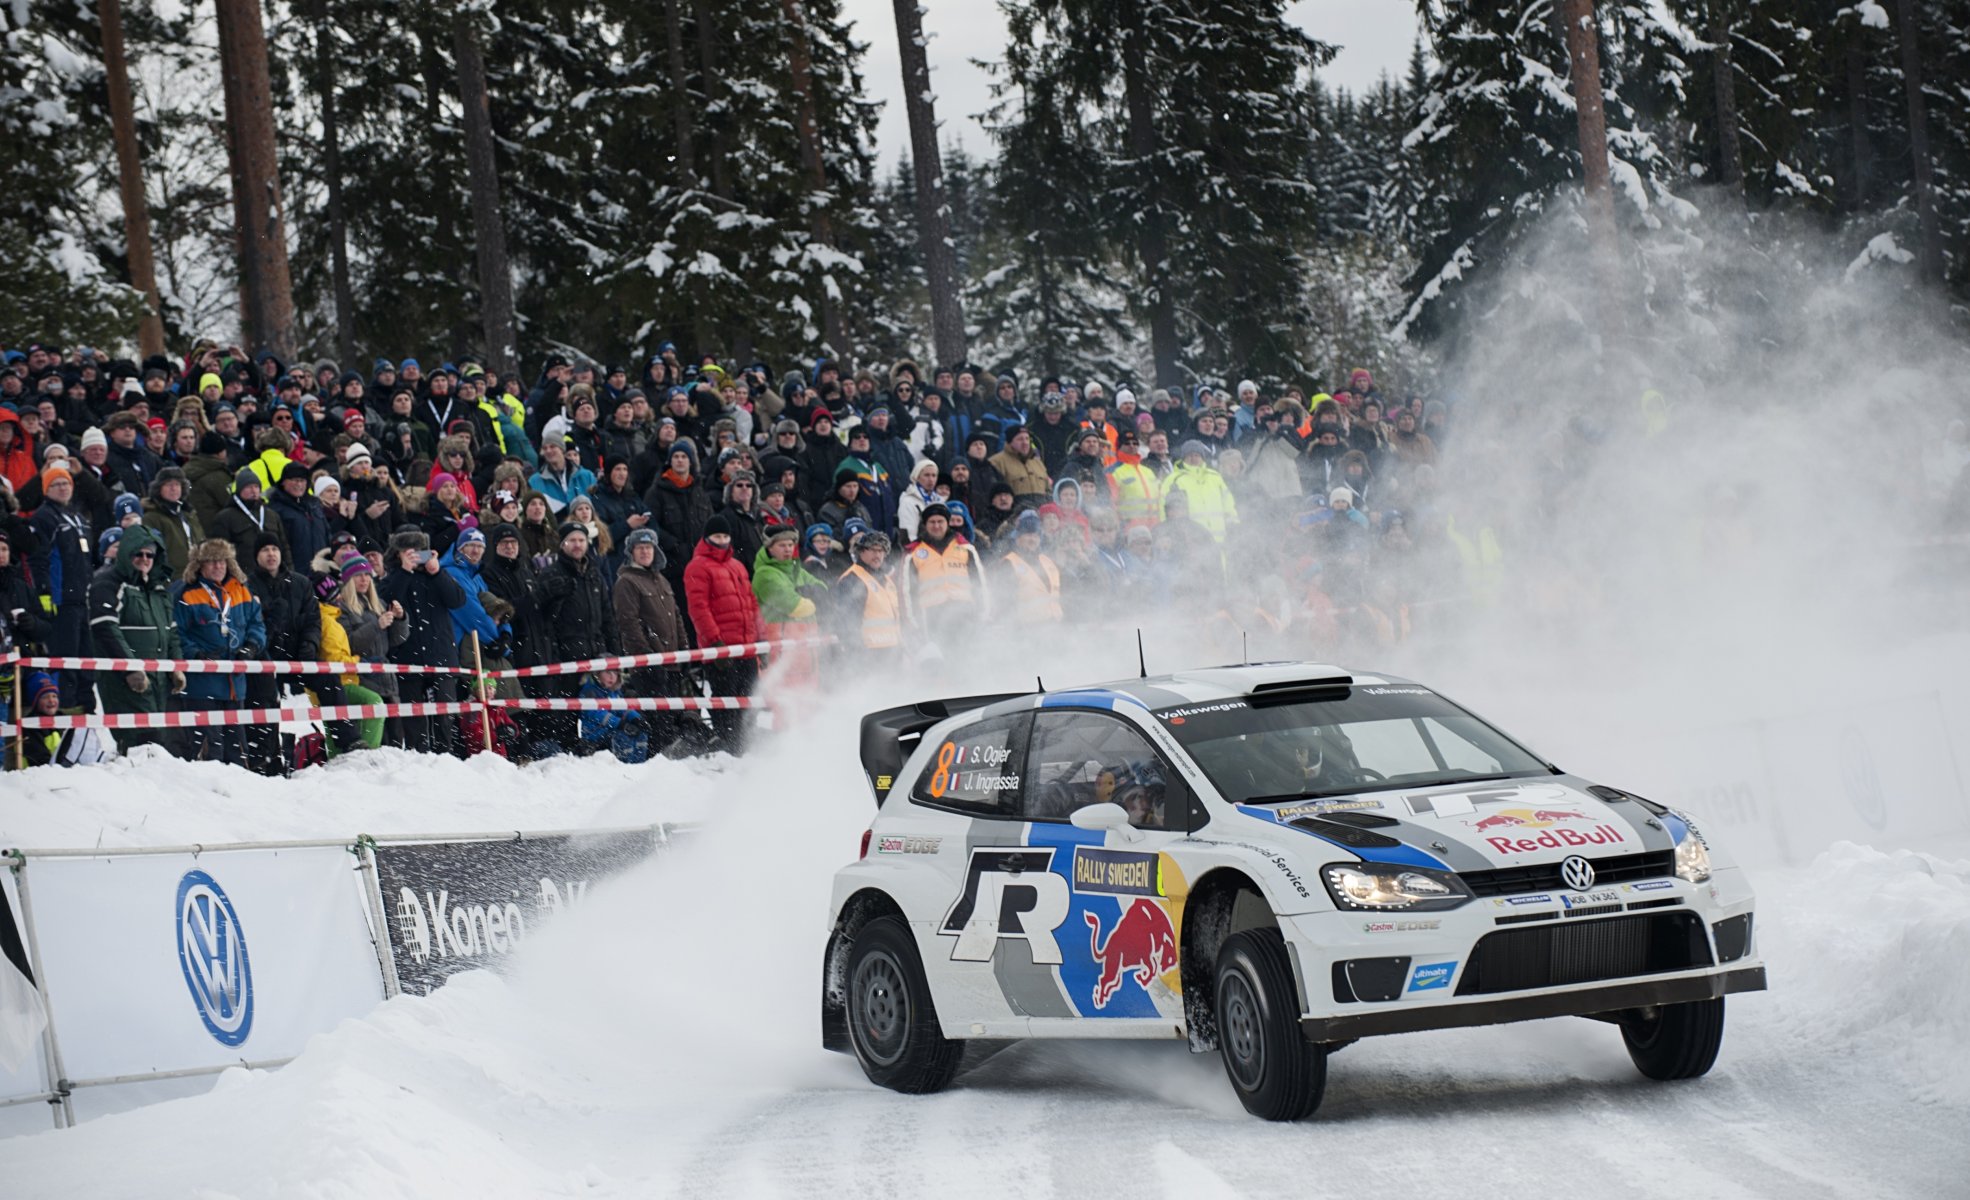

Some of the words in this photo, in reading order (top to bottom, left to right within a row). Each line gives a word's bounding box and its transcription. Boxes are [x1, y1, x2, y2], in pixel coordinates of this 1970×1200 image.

[1157, 701, 1247, 720] Volkswagen
[971, 746, 980, 763] S.
[983, 745, 1012, 767] Ogier
[930, 742, 956, 798] 8
[964, 774, 973, 790] J.
[976, 772, 1020, 794] Ingrassia
[1279, 805, 1319, 817] RALLY
[1323, 800, 1379, 811] SWEDEN
[903, 838, 943, 854] EDGE
[1485, 830, 1561, 854] Red
[1555, 824, 1625, 847] Bull
[1077, 855, 1106, 885] RALLY
[1108, 860, 1150, 887] SWEDEN
[1272, 856, 1311, 898] Services
[1570, 895, 1587, 905] WOB
[1602, 892, 1618, 901] 361
[426, 889, 524, 957] Koneo
[1370, 923, 1394, 932] Castrol
[1397, 921, 1441, 931] EDGE
[1414, 967, 1448, 979] ultimate
